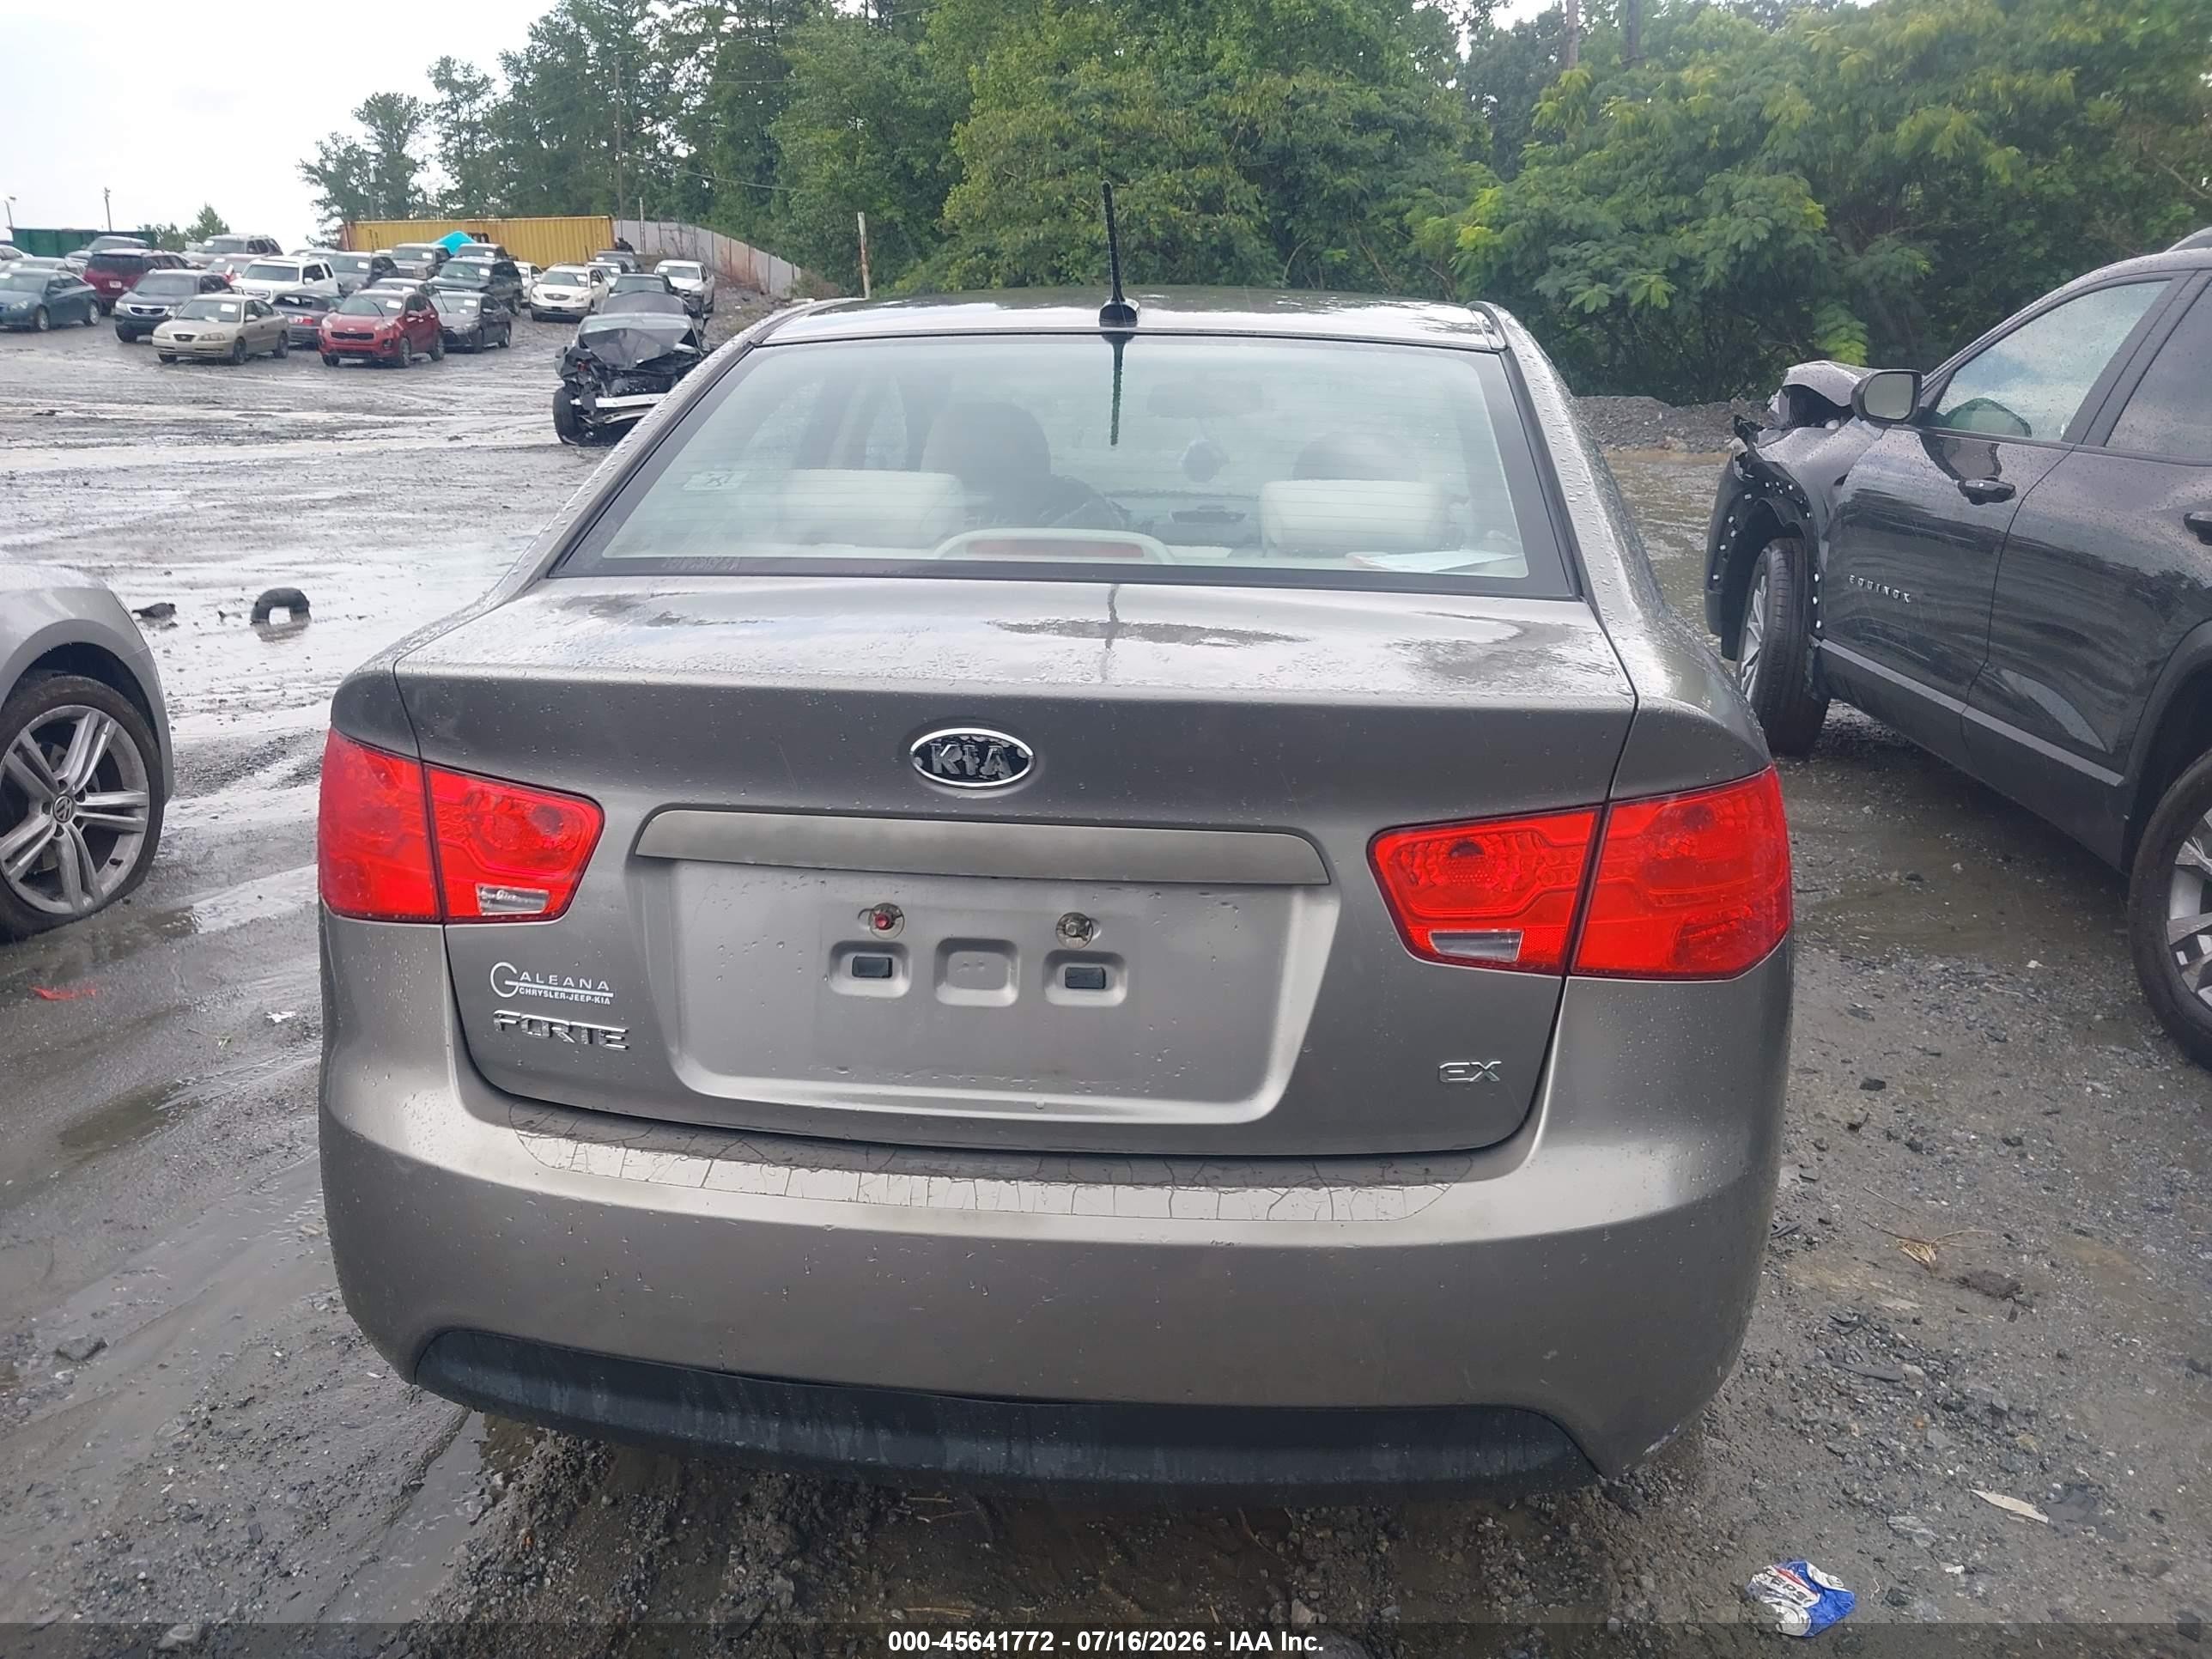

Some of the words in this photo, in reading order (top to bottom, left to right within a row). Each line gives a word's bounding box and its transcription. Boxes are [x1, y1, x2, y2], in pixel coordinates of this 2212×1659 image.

[1849, 574, 1911, 604] EQUINOX
[929, 742, 1013, 780] KIA
[490, 961, 611, 998] GALEANA
[493, 1009, 630, 1050] FORTE
[1438, 1060, 1502, 1082] EX
